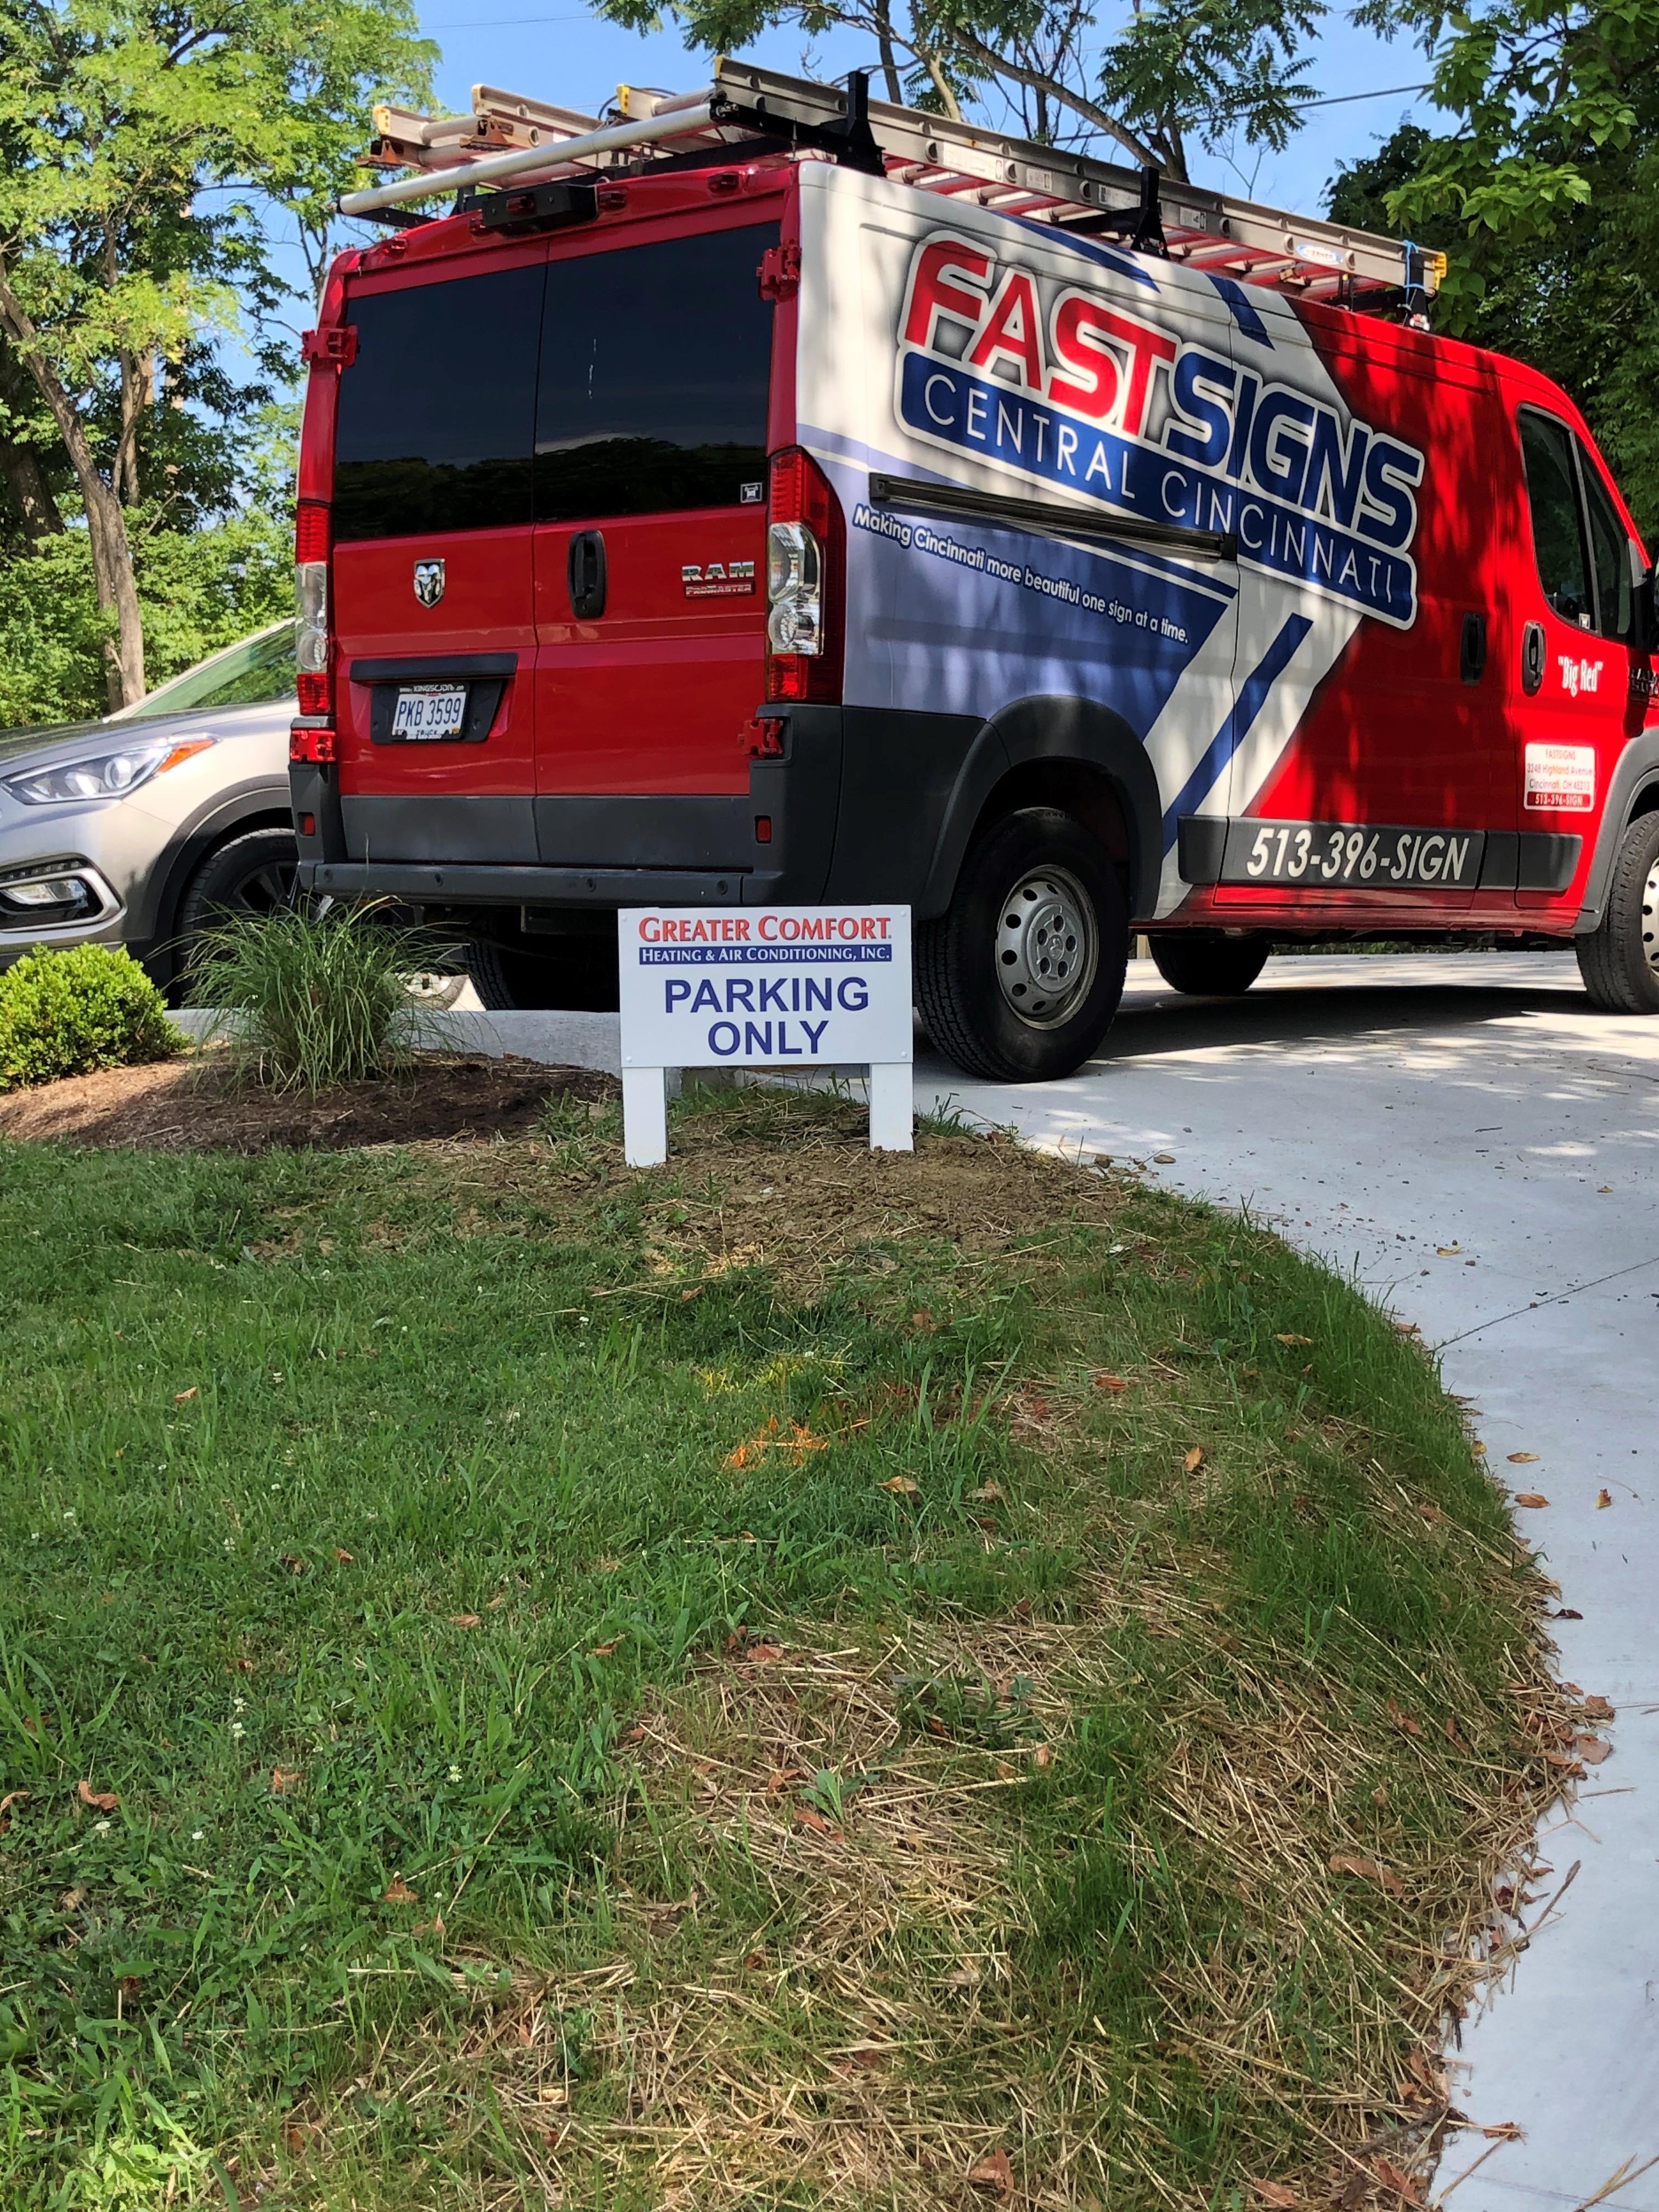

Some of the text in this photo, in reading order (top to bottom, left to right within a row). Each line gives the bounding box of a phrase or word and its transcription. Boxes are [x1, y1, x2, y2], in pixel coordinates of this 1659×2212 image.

[904, 240, 1421, 549] FASTSIGNS
[924, 374, 1392, 603] CENTRAL CINCINNATI
[681, 561, 755, 582] RAM
[854, 506, 1189, 644] Making Cincinnati more beautiful one sign at a time.
[1558, 655, 1578, 697] "Big
[1579, 659, 1604, 692] Red"
[396, 697, 461, 727] PKB 3599
[1246, 827, 1470, 881] 513-396-SIGN
[638, 915, 891, 943] GREATER COMFORT
[642, 945, 890, 962] HEATING & AIR CONDITIONING, INC.
[665, 977, 868, 1014] PARKING
[708, 1020, 830, 1056] ONLY
